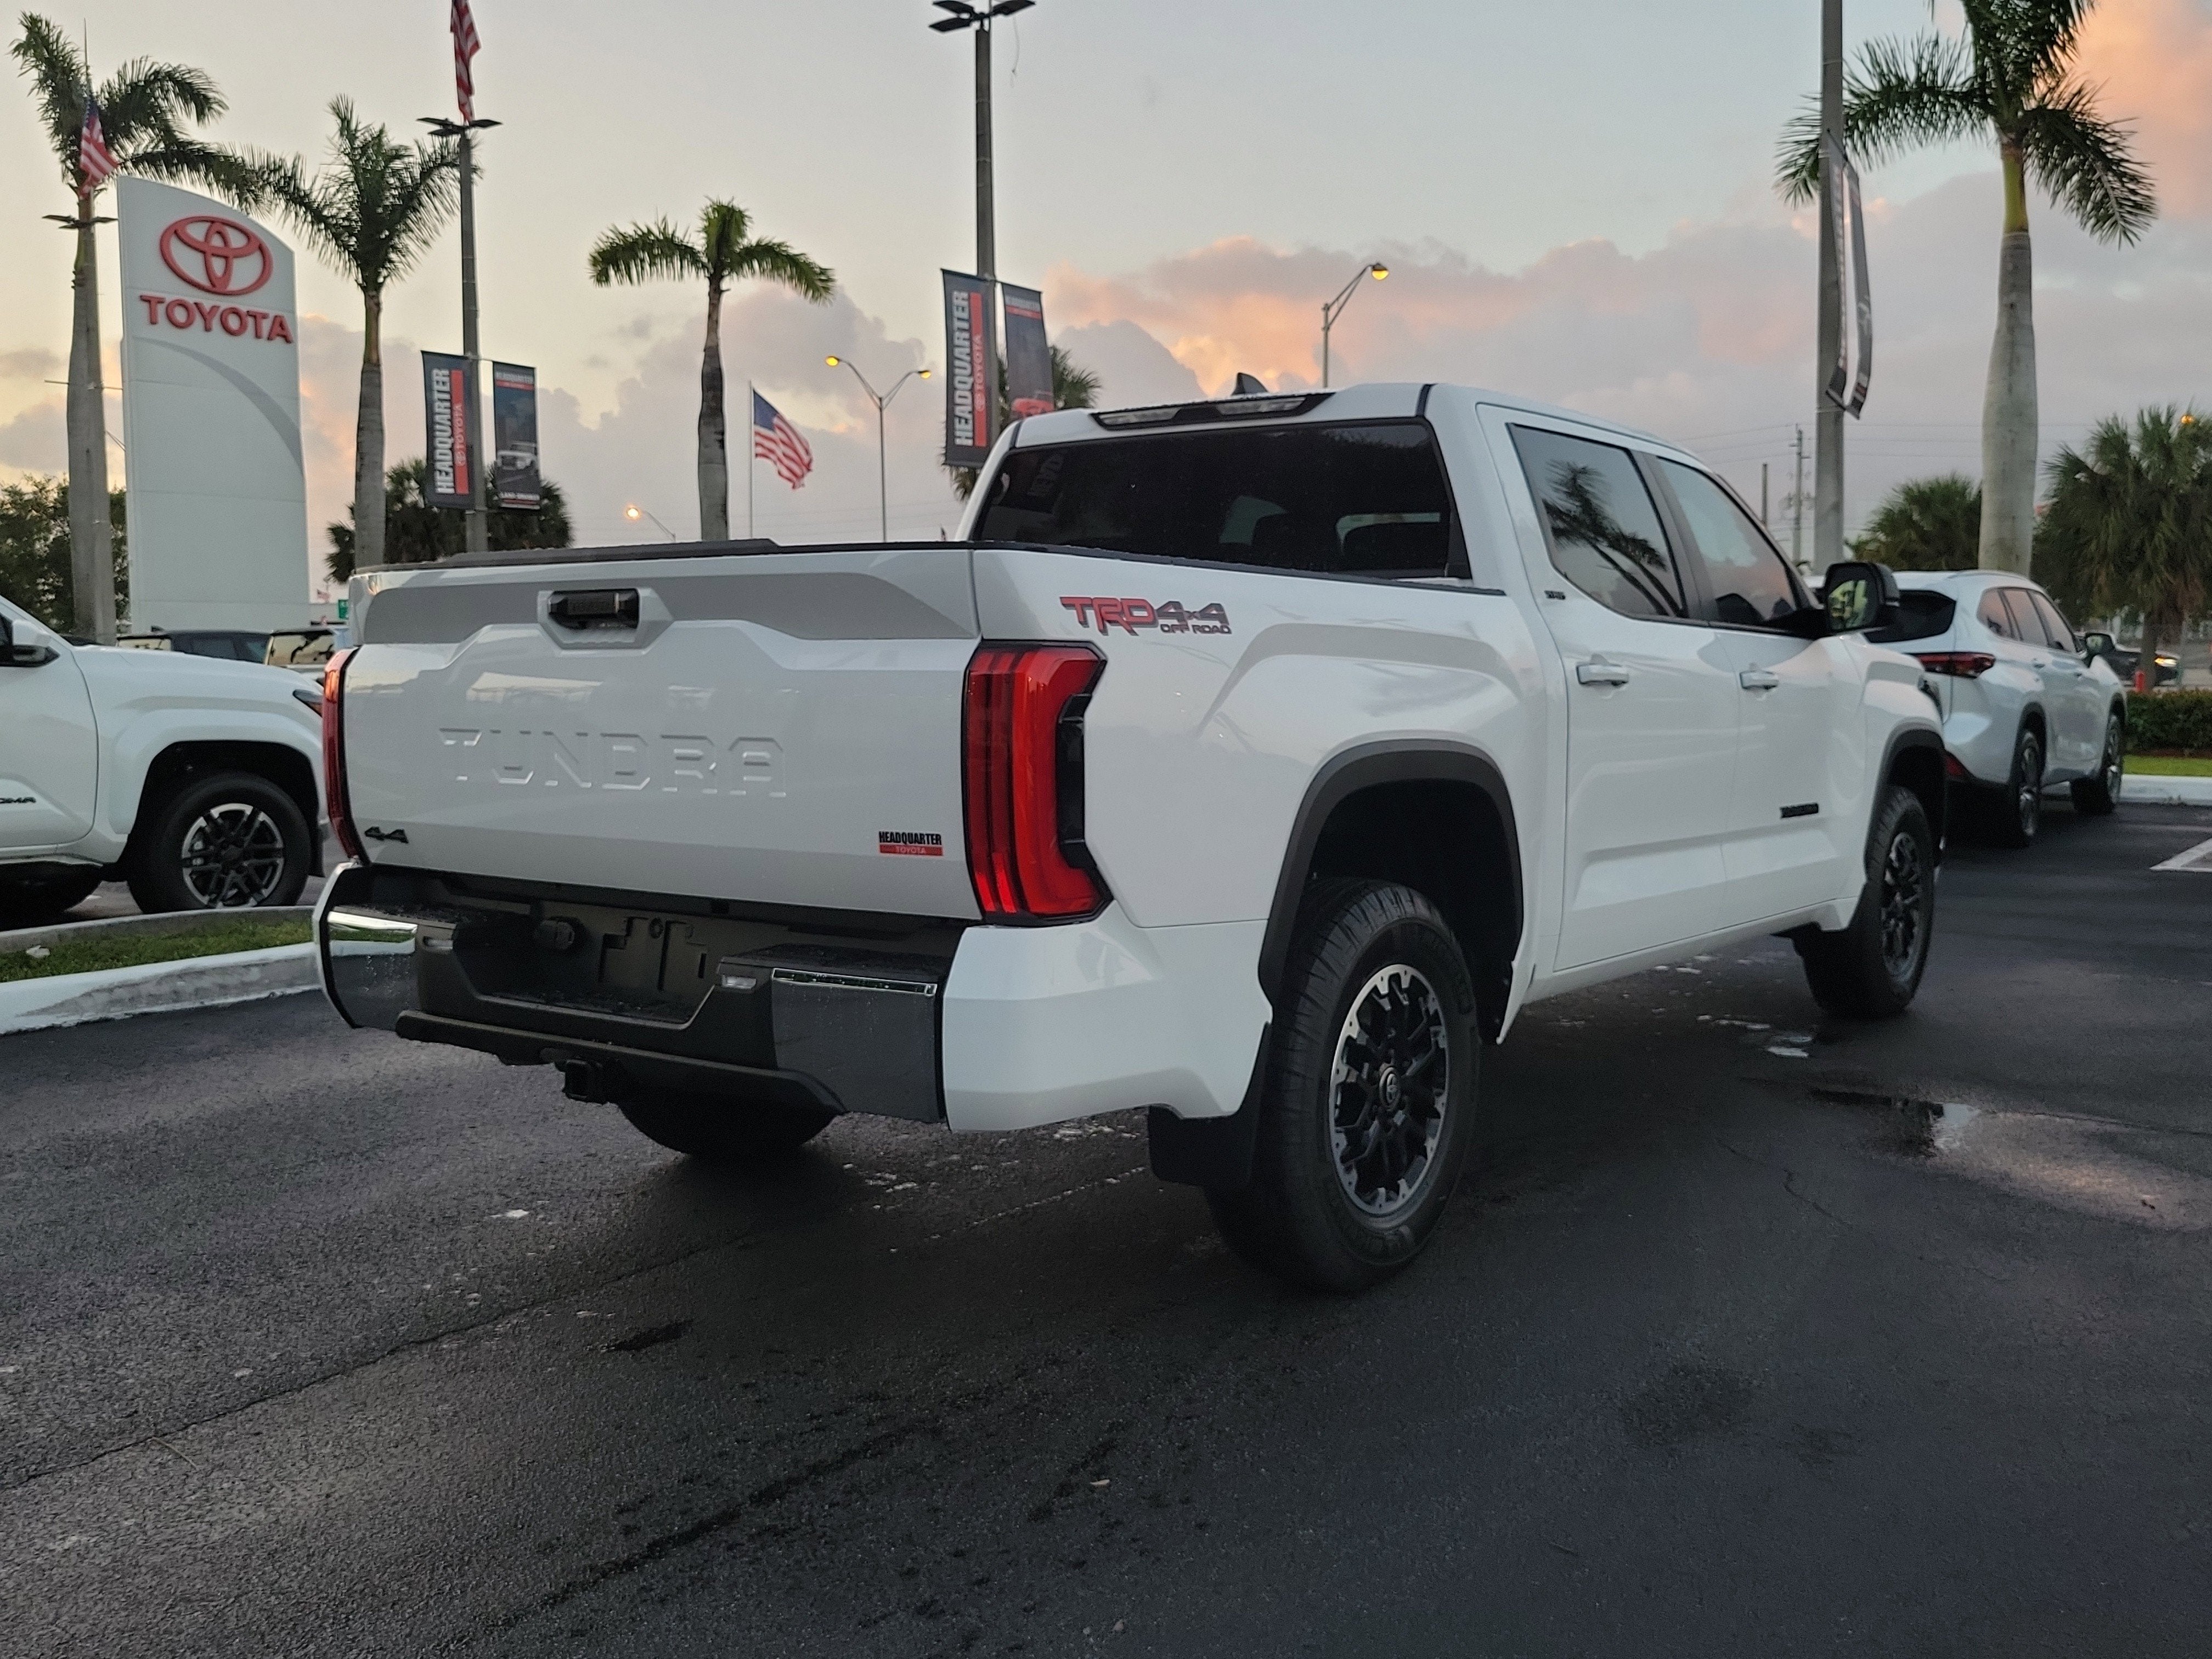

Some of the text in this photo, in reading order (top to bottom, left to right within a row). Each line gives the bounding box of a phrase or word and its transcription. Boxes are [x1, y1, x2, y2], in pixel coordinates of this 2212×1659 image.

[140, 295, 293, 343] TOYOTA
[952, 291, 973, 445] HEADQUARTER
[973, 335, 984, 390] TOYOTA
[433, 369, 454, 493] HEADQUARTER
[454, 405, 465, 449] TOYOTA
[1059, 596, 1158, 636] TRD
[1160, 623, 1232, 634] OFF ROAD
[439, 728, 787, 797] TUNDRA
[879, 831, 941, 845] HEADQUARTER
